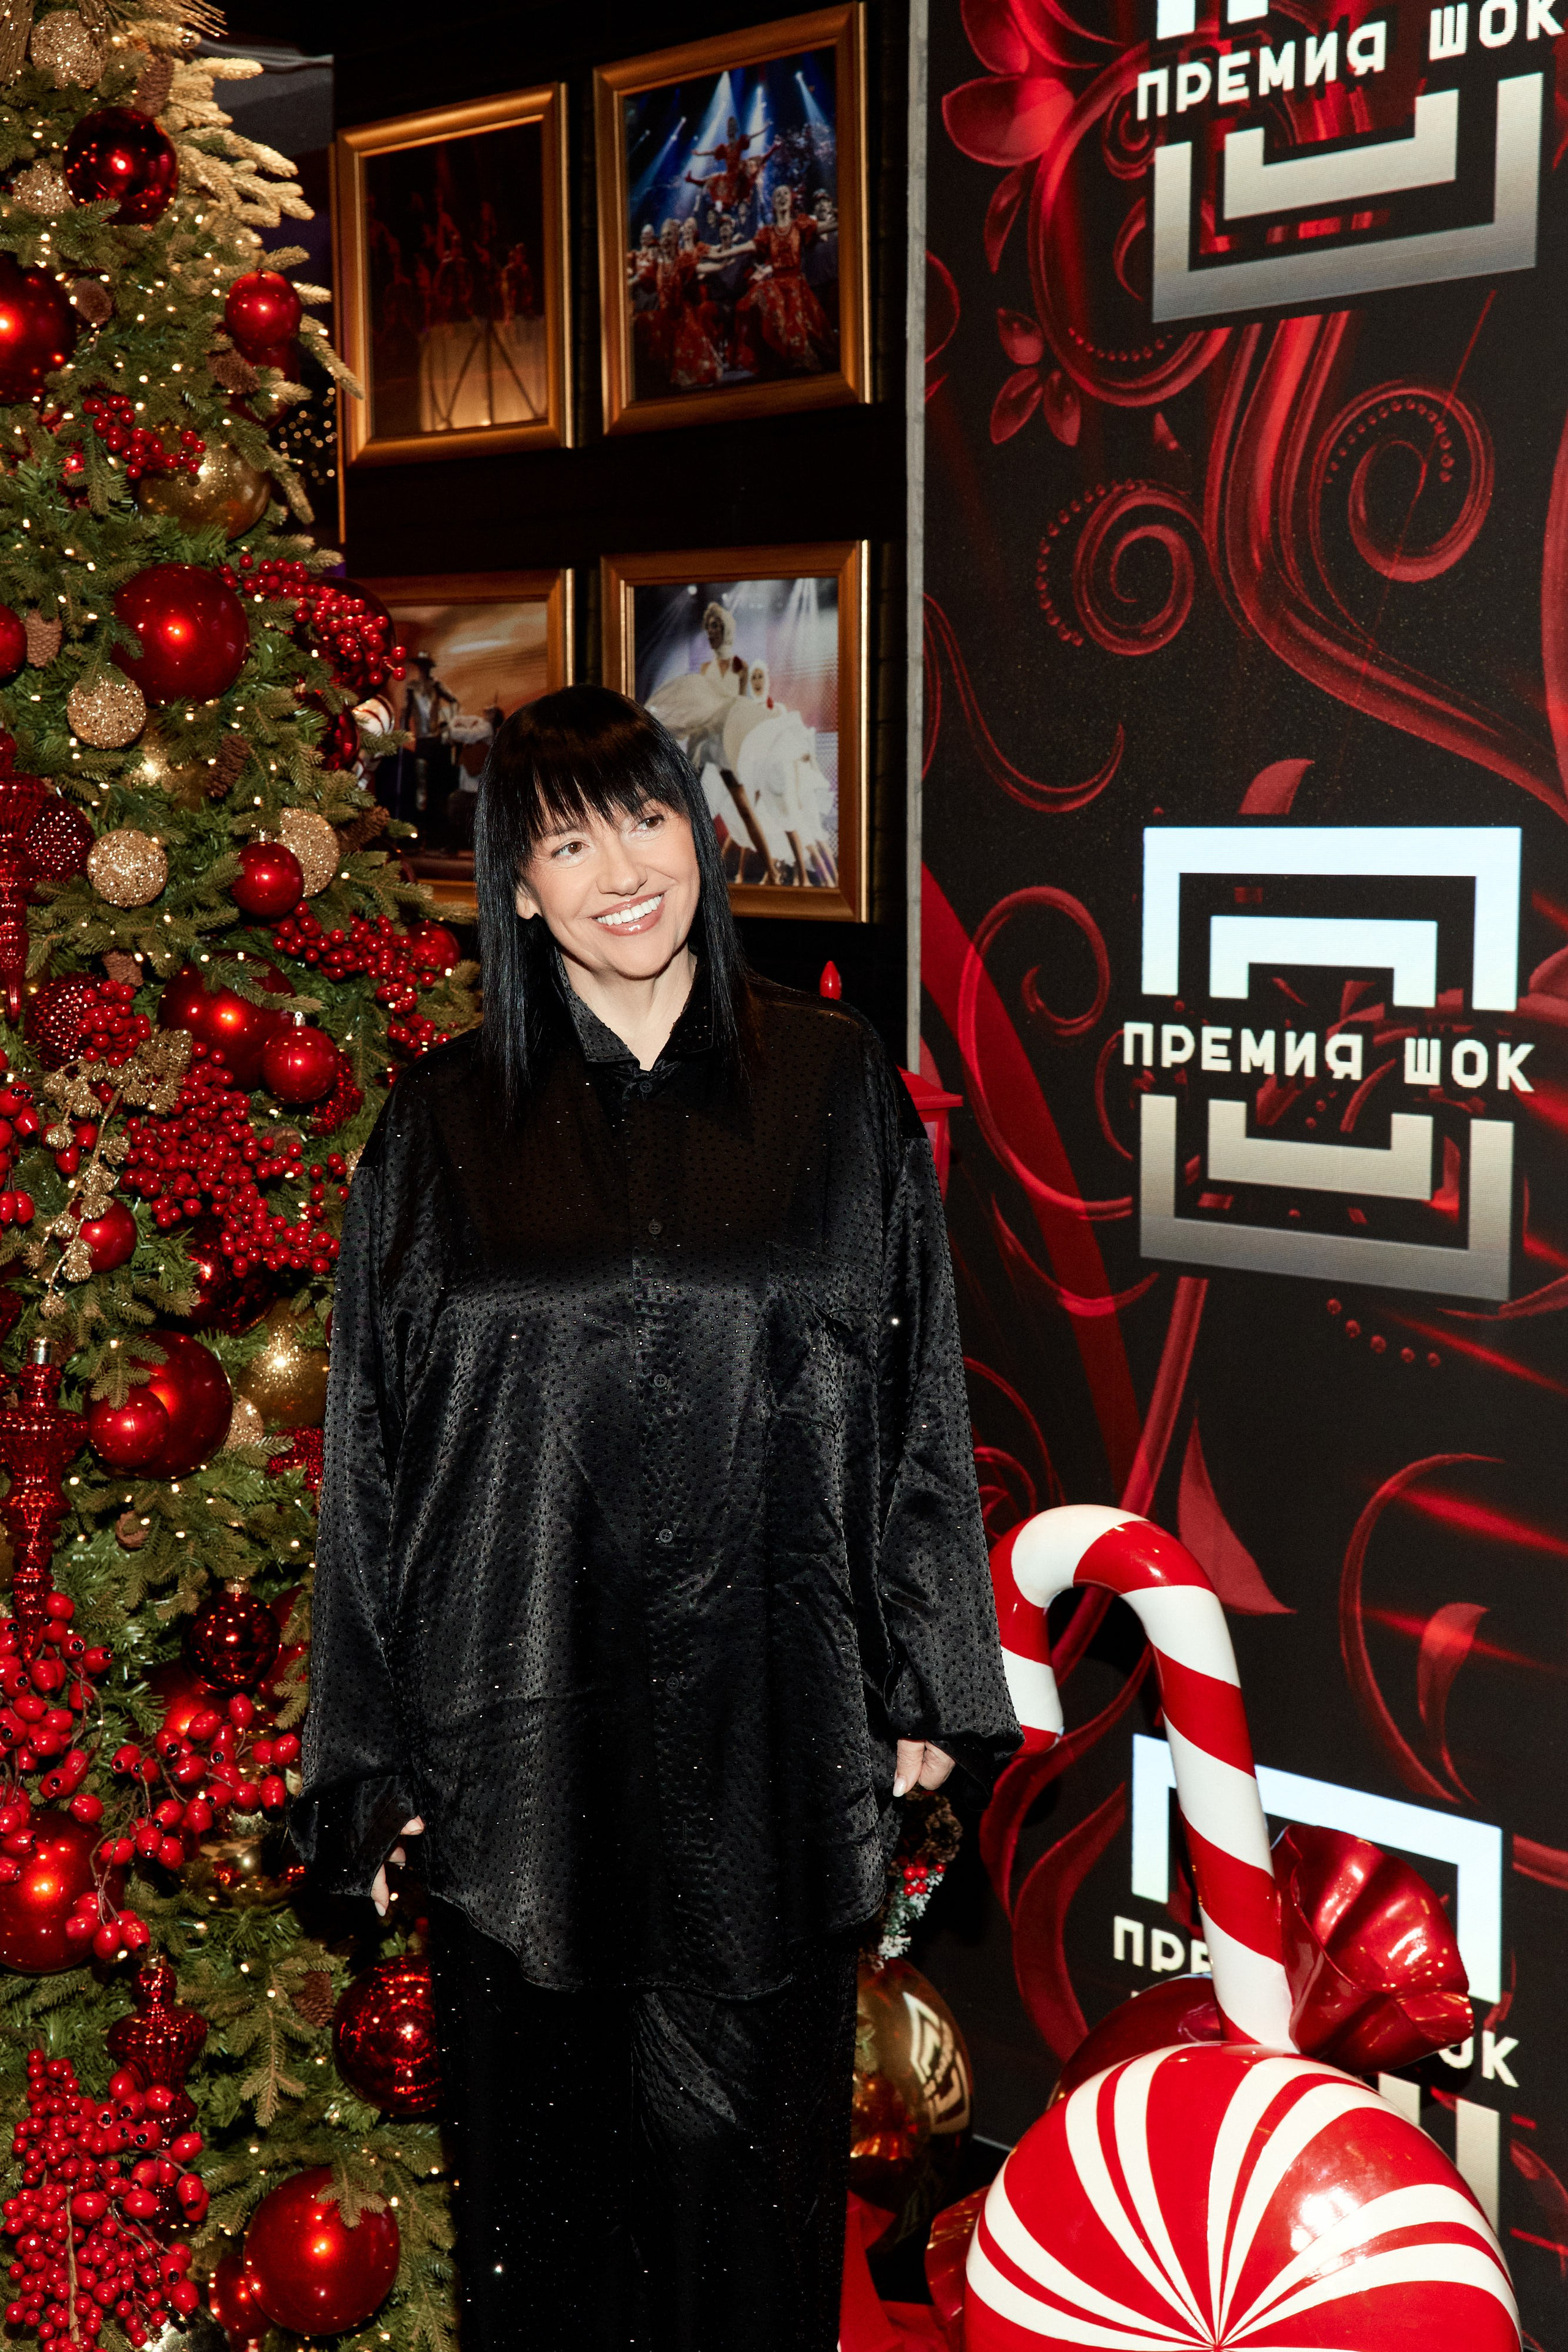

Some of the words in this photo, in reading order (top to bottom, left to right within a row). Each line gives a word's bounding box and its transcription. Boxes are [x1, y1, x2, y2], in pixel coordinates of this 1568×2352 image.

[1137, 21, 1387, 121] ПРЕМИЯ
[1428, 0, 1566, 61] ШОК
[1123, 1022, 1363, 1080] ПРЕМИЯ
[1404, 1037, 1535, 1092] ШОК
